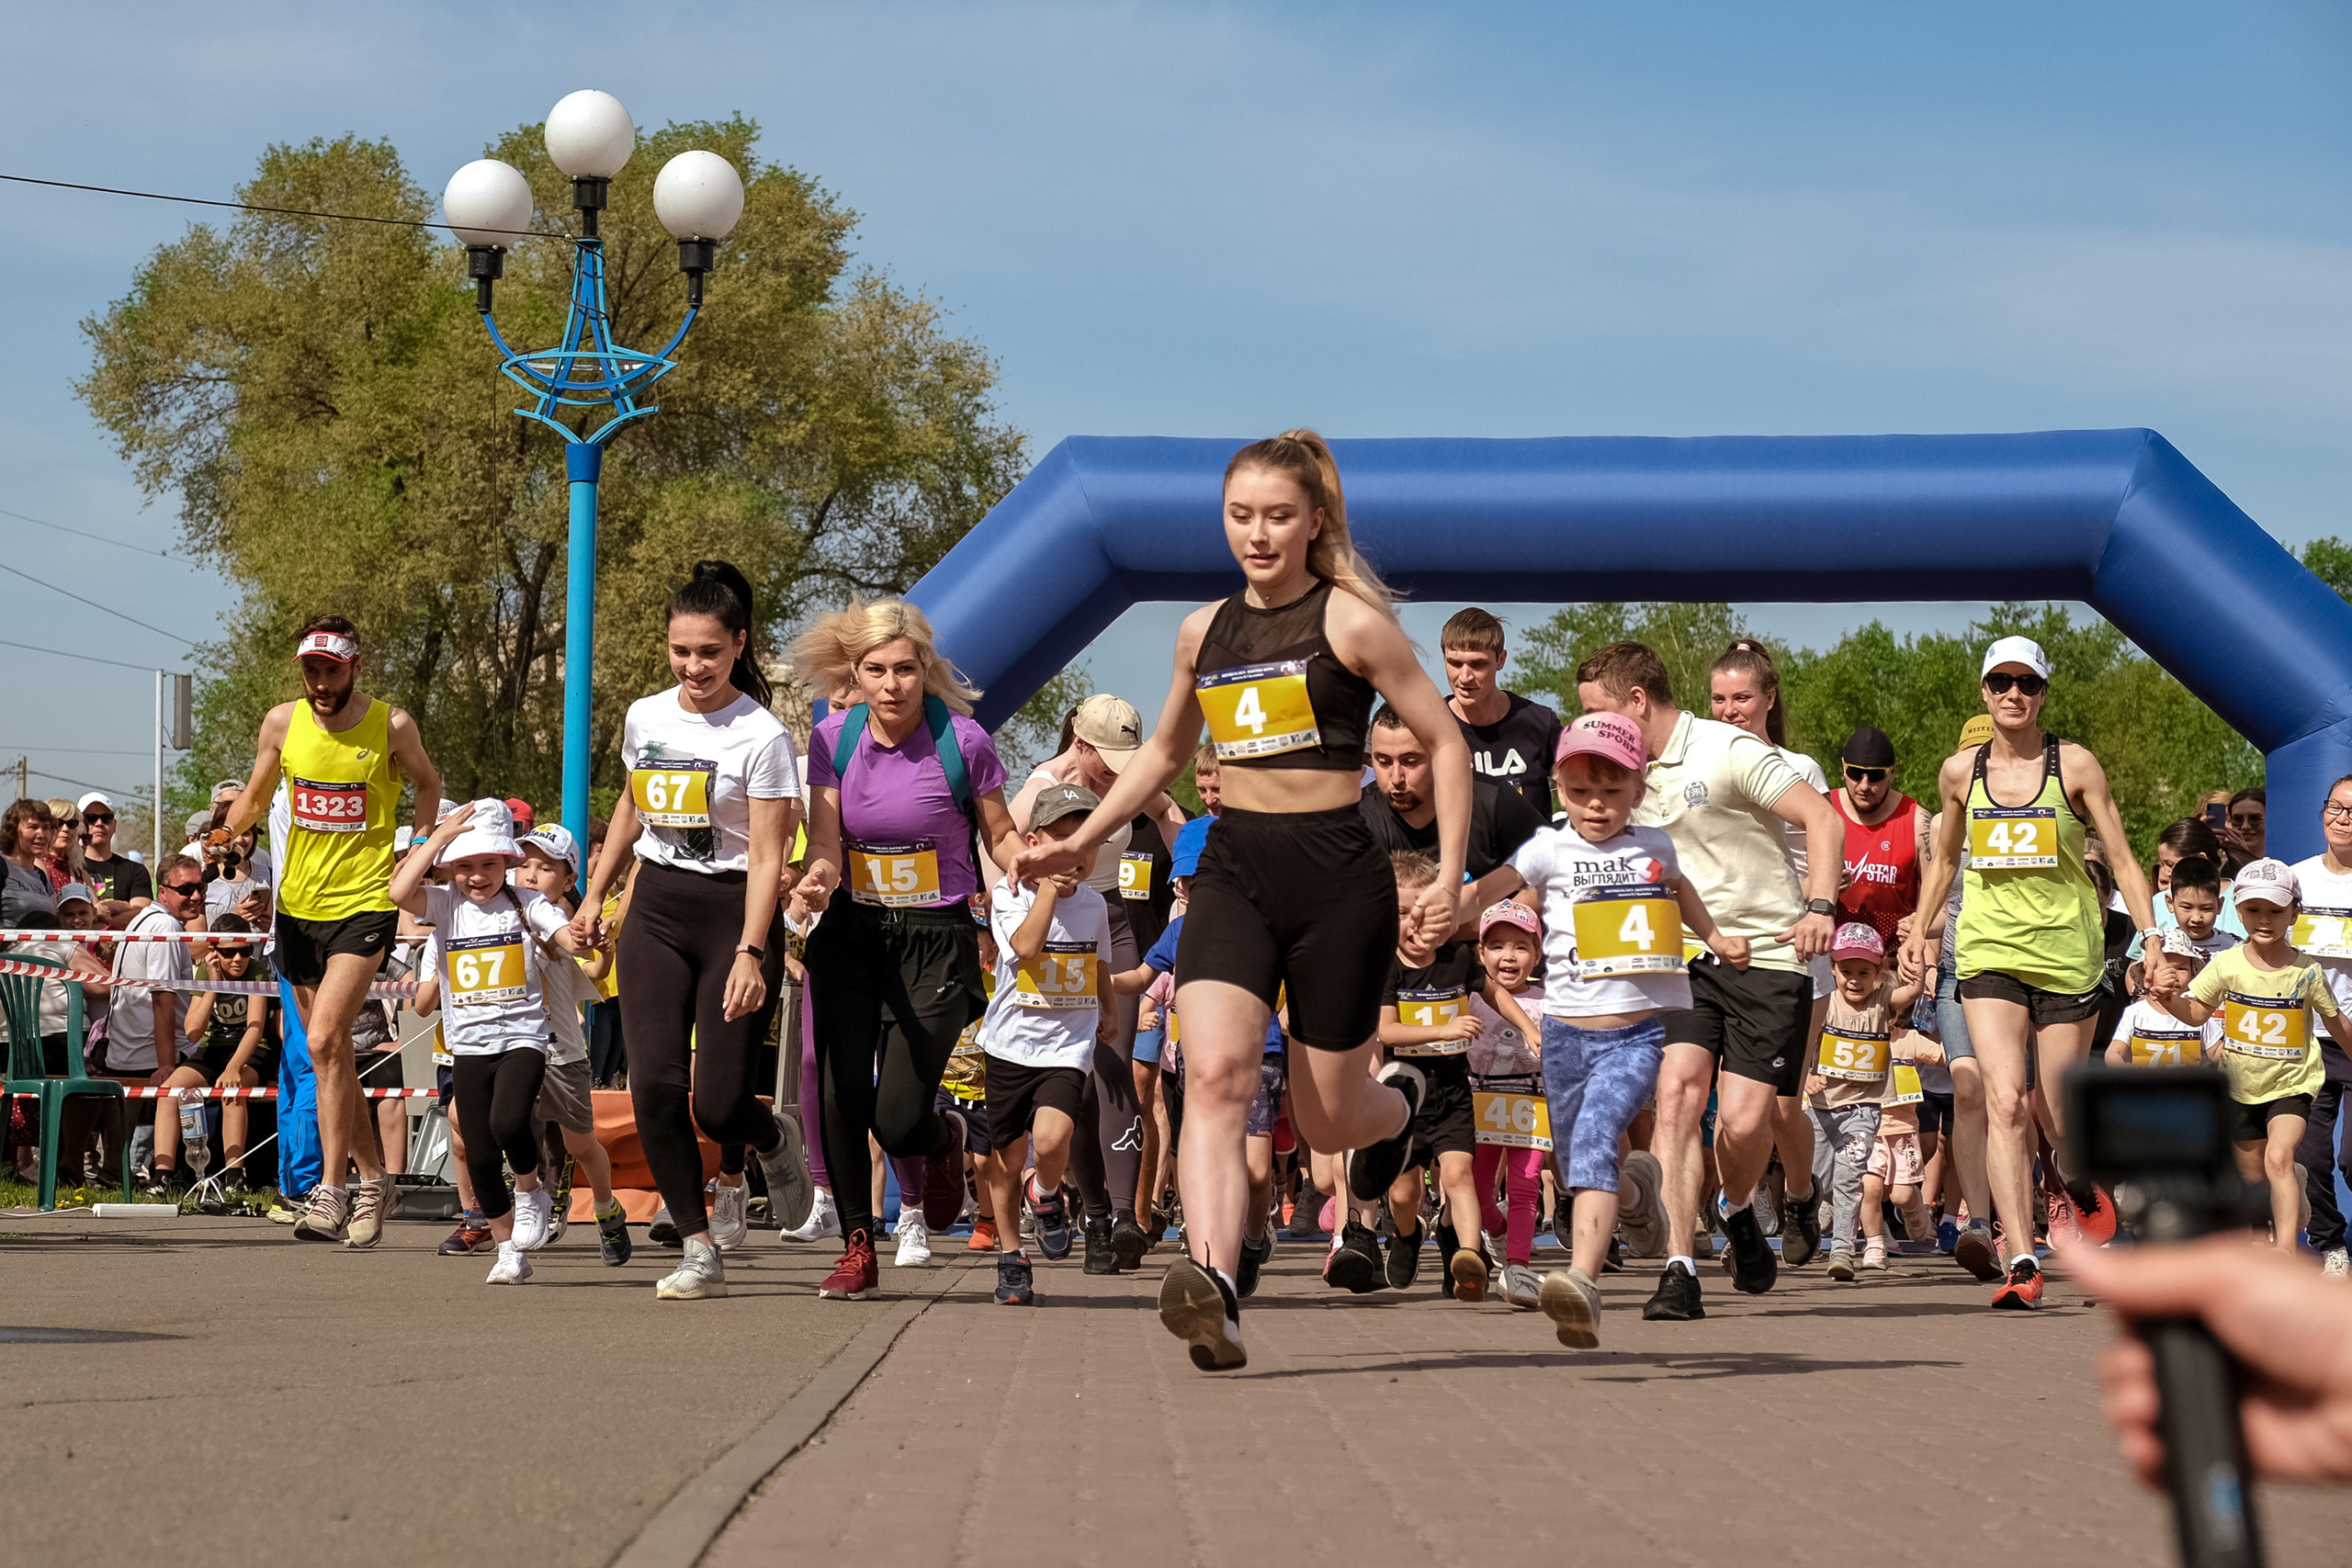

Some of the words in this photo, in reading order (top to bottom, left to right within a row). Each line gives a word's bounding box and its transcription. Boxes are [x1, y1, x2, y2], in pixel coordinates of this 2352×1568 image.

[1234, 686, 1267, 735] 4
[1582, 720, 1635, 744] SUMMER
[1598, 729, 1636, 753] SPORT
[1471, 748, 1527, 777] ILA
[297, 792, 364, 817] 1323
[646, 773, 691, 810] 67
[1063, 789, 1080, 800] LA
[1987, 821, 2038, 854] 42
[865, 858, 919, 891] 15
[1573, 872, 1637, 887] ВЫГЛЯДИТ
[1619, 904, 1656, 951] 4
[456, 951, 505, 988] 67
[1036, 957, 1085, 993] 15
[2238, 1010, 2288, 1044] 42
[1833, 1040, 1876, 1070] 52
[2145, 1043, 2187, 1067] 71
[1484, 1096, 1537, 1133] 46
